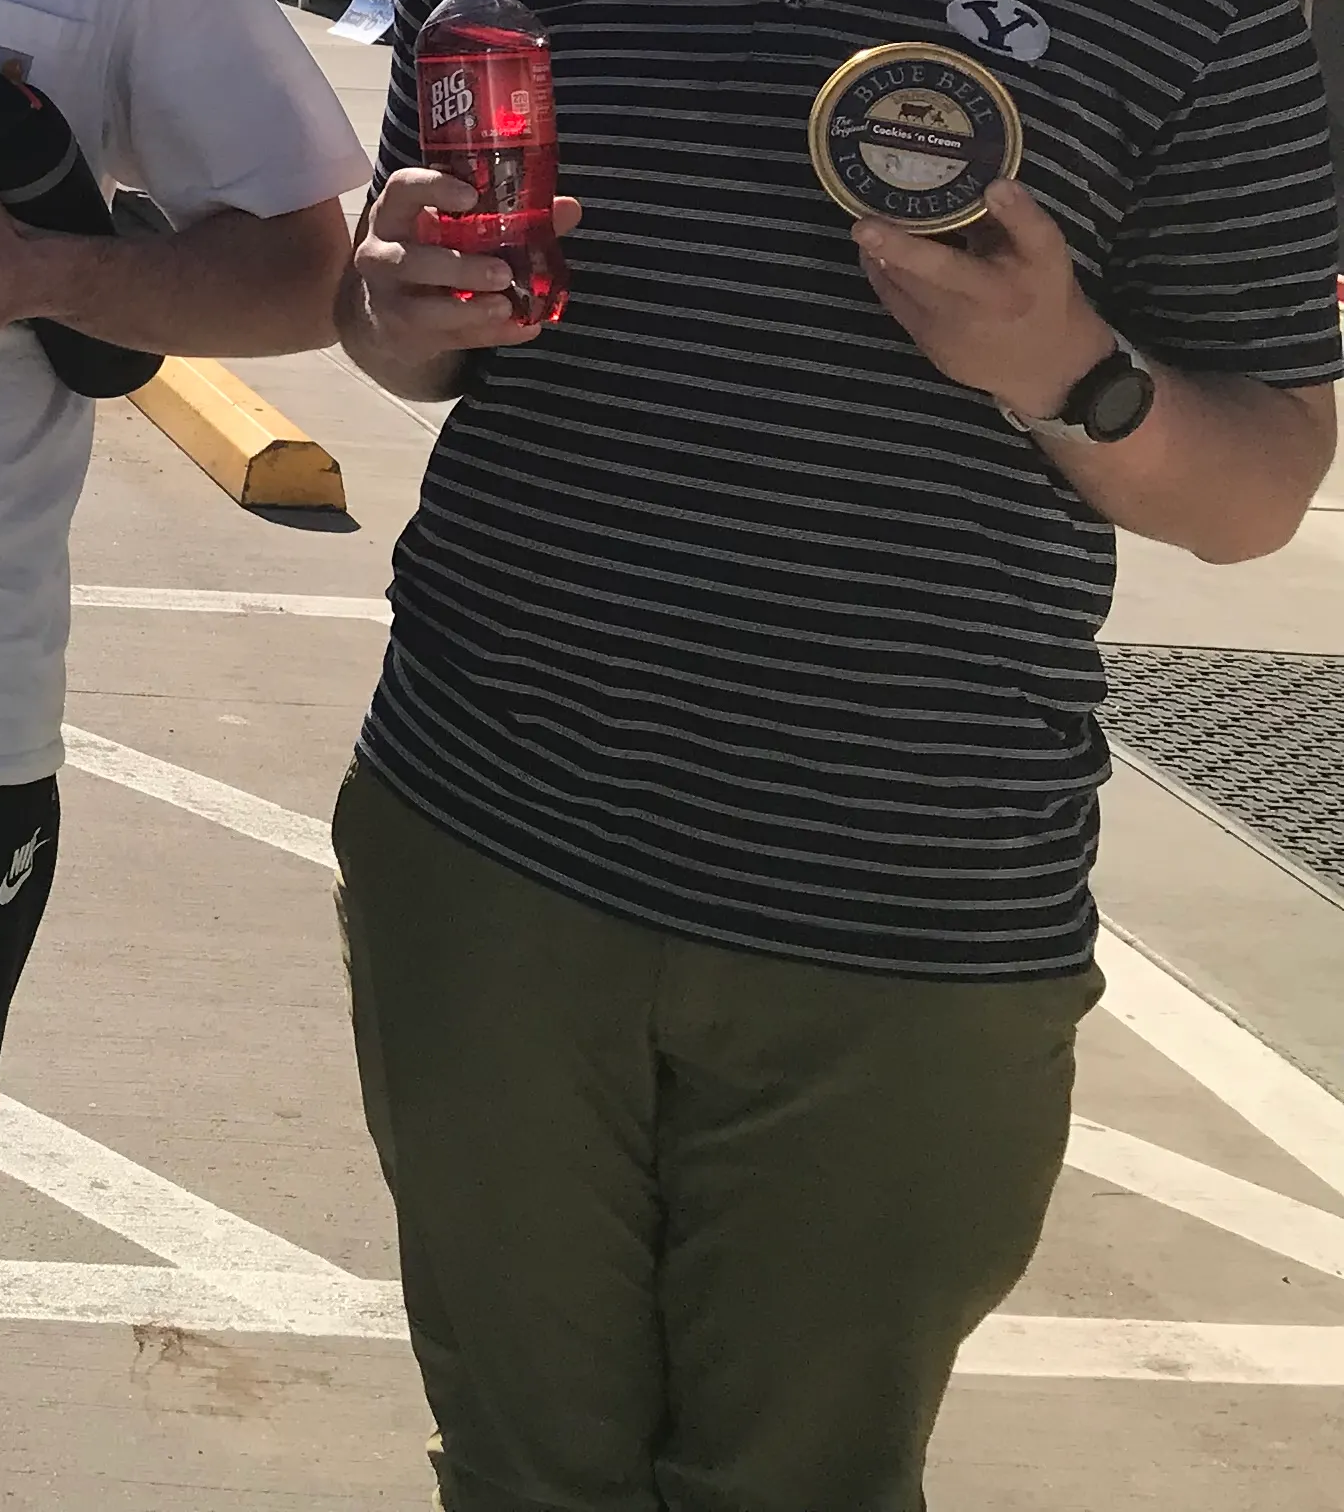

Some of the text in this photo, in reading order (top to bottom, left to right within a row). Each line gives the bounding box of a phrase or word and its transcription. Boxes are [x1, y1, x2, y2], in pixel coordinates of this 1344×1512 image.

[961, 0, 1038, 52] Y
[431, 68, 466, 106] BIG
[432, 89, 473, 129] RED
[853, 65, 925, 104] BLUE
[936, 71, 992, 125] BELL
[872, 124, 912, 139] Cookies
[927, 135, 961, 149] Cream
[839, 152, 982, 214] ICE CREAM
